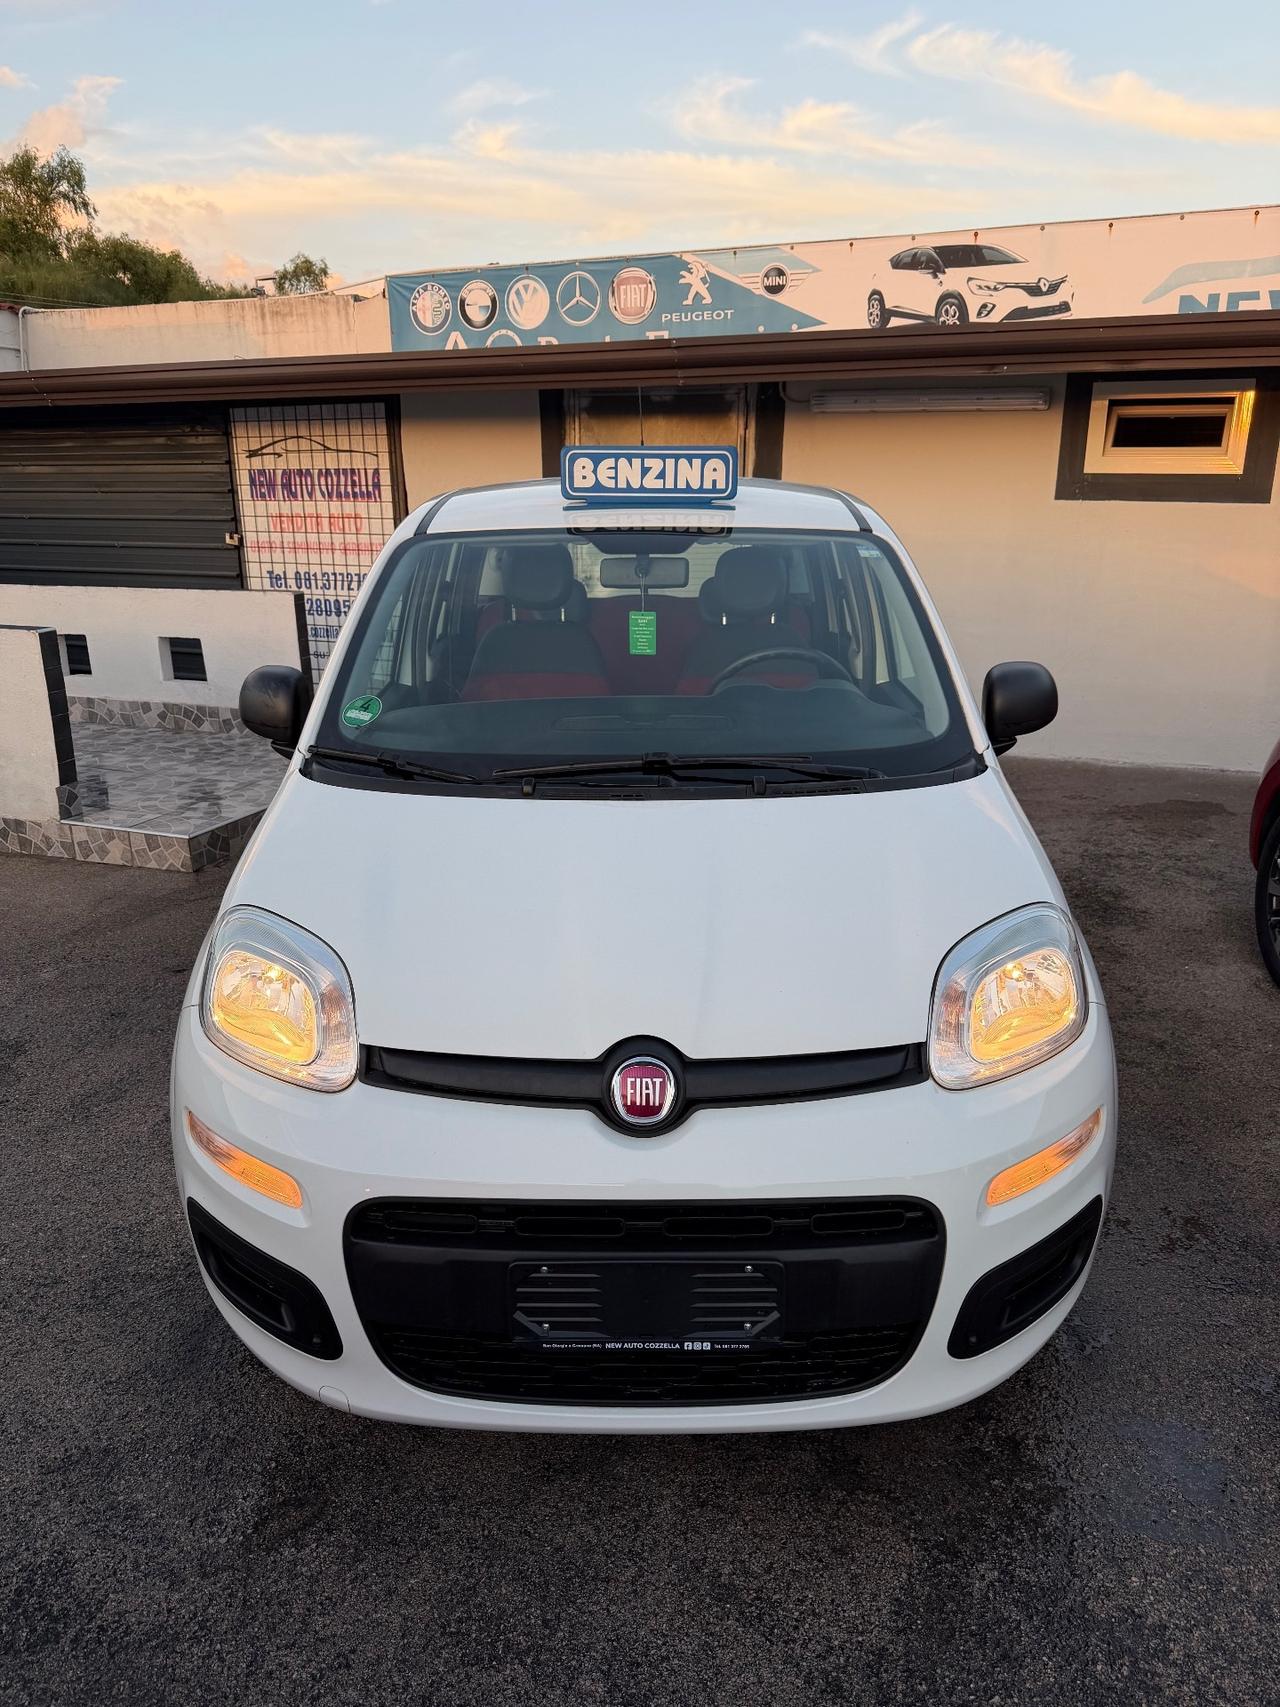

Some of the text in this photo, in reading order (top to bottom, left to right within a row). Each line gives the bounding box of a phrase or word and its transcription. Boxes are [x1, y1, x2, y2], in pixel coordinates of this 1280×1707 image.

[763, 276, 787, 287] MINI
[620, 283, 647, 309] FIAT
[661, 309, 735, 324] PEUGEOT
[573, 457, 726, 490] BENZINA
[248, 467, 382, 502] NEW AUTO COZZELLA
[270, 512, 364, 533] VENDITA AUTO
[267, 571, 292, 589] Tel.
[306, 598, 354, 617] 28095
[627, 1077, 663, 1106] FIAT
